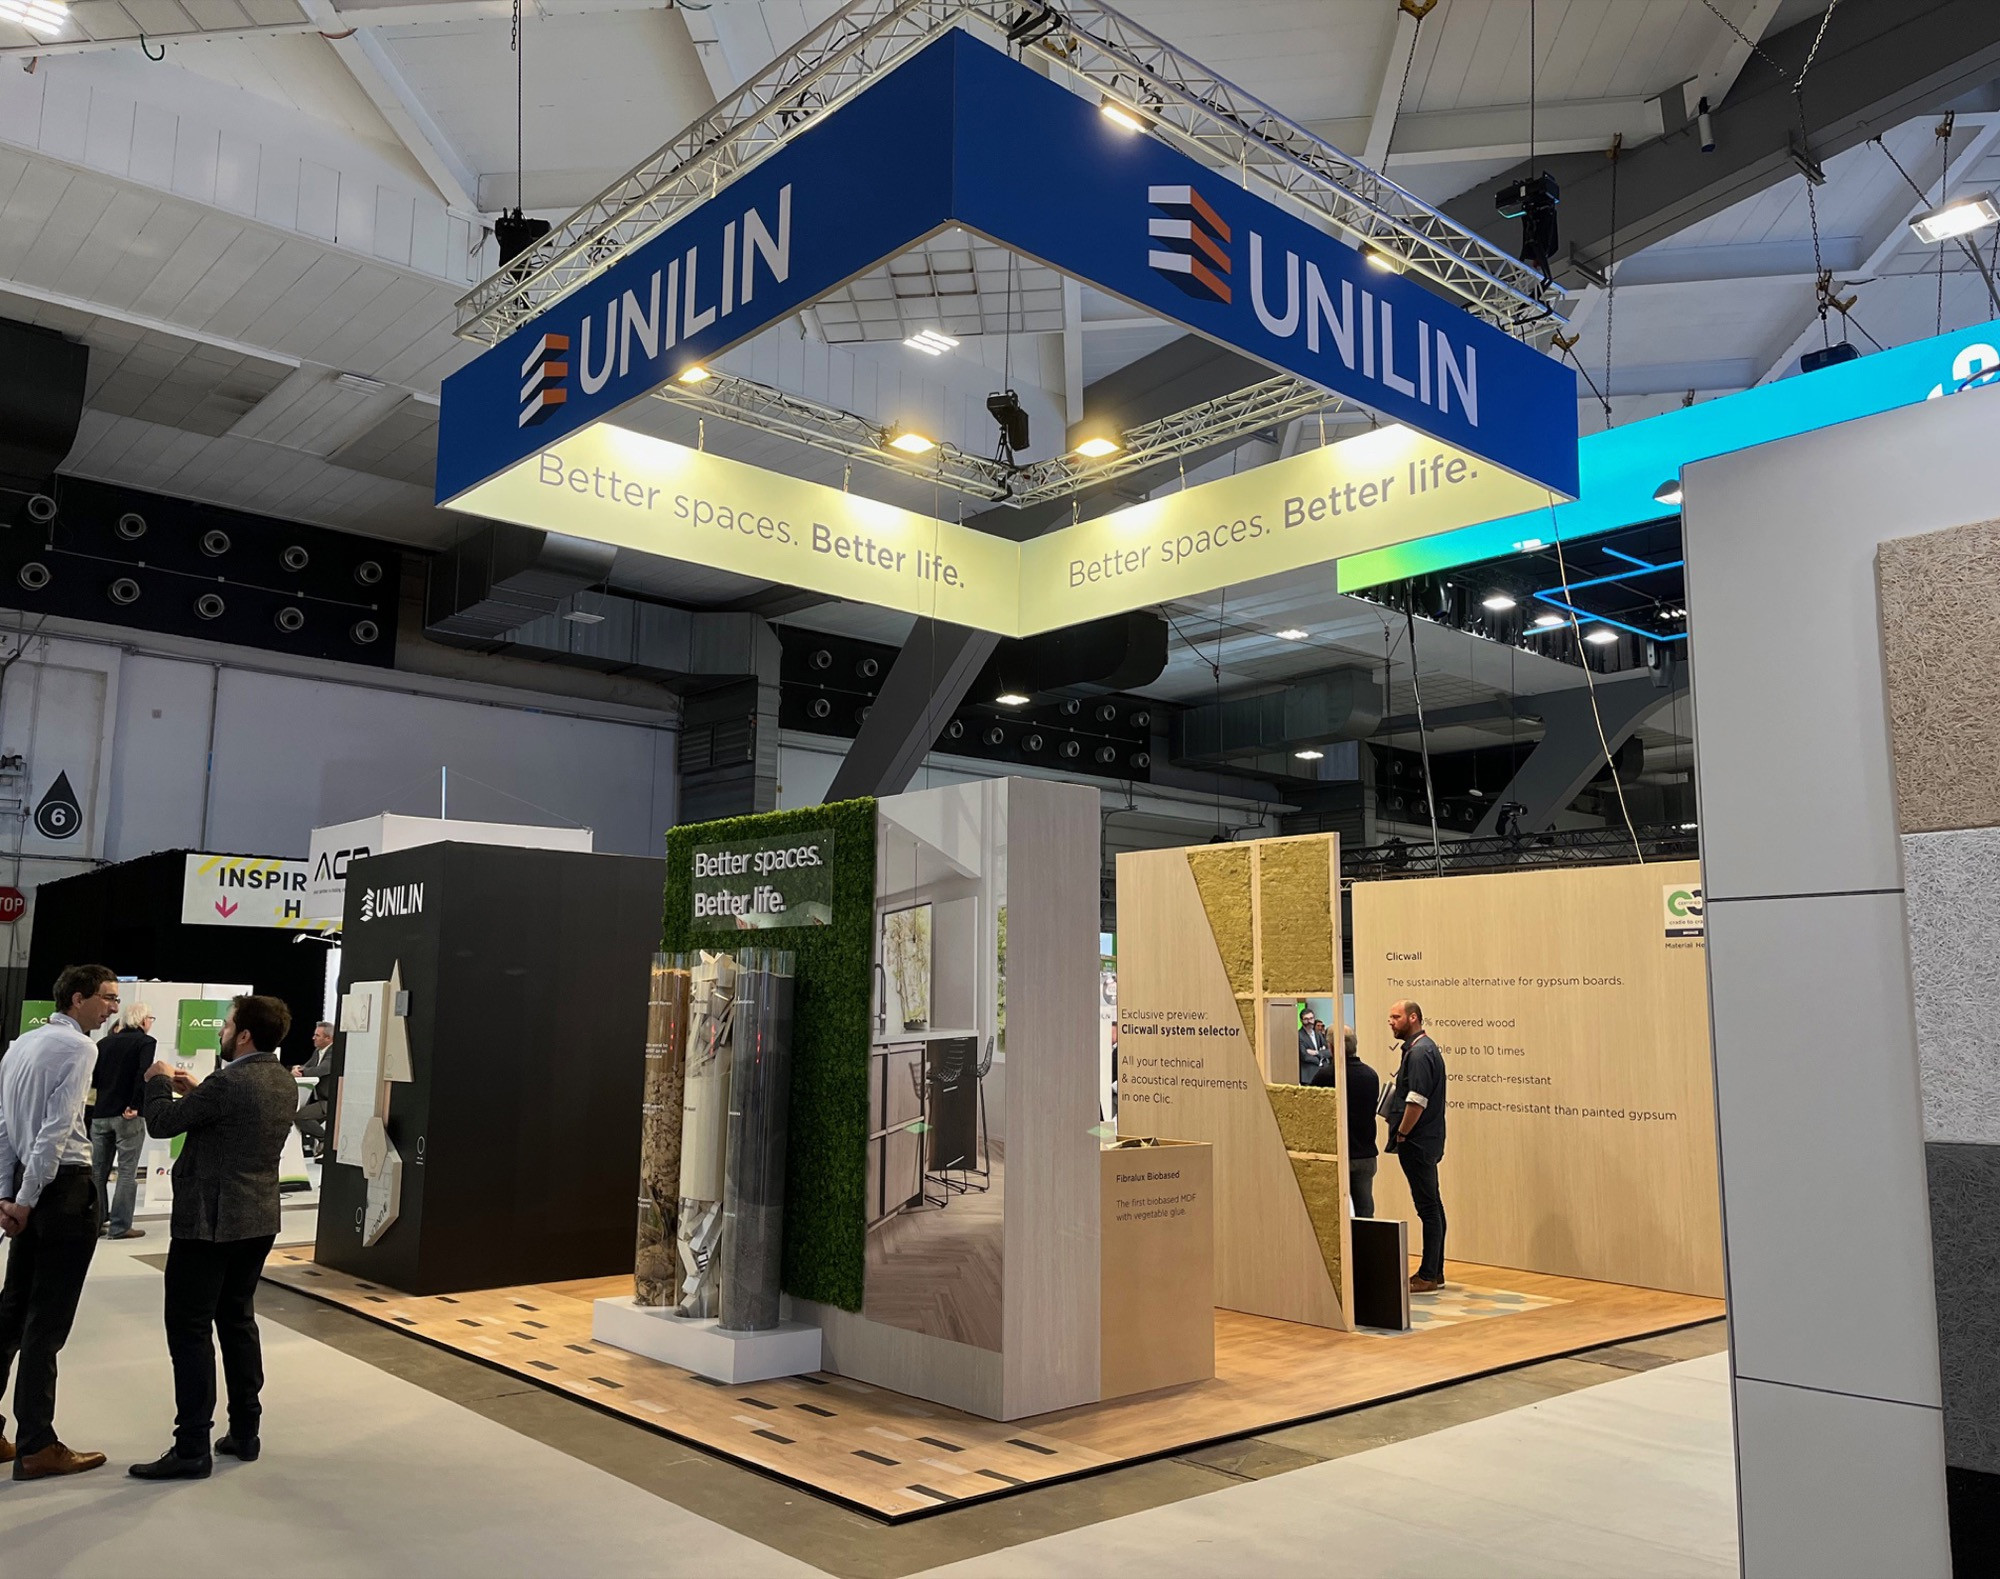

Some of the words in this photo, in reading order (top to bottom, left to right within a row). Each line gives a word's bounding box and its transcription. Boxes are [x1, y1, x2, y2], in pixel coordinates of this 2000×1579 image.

[580, 183, 792, 395] UNILIN
[1249, 231, 1478, 427] UNILIN
[539, 453, 661, 510] Better
[674, 494, 798, 546] spaces.
[812, 523, 906, 572] Better
[917, 550, 965, 588] life.
[1069, 541, 1151, 588] Better
[1161, 514, 1271, 565] spaces.
[1284, 476, 1394, 529] Better
[1408, 453, 1478, 496] life.
[51, 808, 66, 826] 6
[695, 851, 752, 878] Better
[753, 845, 823, 876] spaces.
[375, 882, 424, 917] UNILIN
[694, 890, 751, 917] Better
[753, 884, 787, 913] life.
[1665, 941, 1693, 949] Material
[1386, 951, 1422, 961] Clicwall
[1387, 977, 1404, 987] The
[1406, 977, 1460, 987] sustainable
[1462, 977, 1516, 987] alternative
[1518, 976, 1533, 986] for
[1536, 977, 1580, 987] gypsum
[1582, 975, 1625, 986] boards.
[1121, 1008, 1164, 1020] Exclusive
[1166, 1010, 1208, 1021] preview:
[1435, 1017, 1484, 1027] recovered
[1486, 1018, 1516, 1028] wood
[1121, 1023, 1159, 1035] Clicwall
[1161, 1025, 1196, 1037] system
[1198, 1025, 1240, 1036] selector
[1455, 1046, 1467, 1056] up
[1470, 1045, 1480, 1055] to
[1483, 1045, 1494, 1055] 10
[1497, 1046, 1526, 1056] times
[1121, 1055, 1134, 1066] All
[1137, 1058, 1158, 1068] your
[1160, 1057, 1204, 1069] technical
[1121, 1073, 1128, 1083] &
[1131, 1074, 1178, 1086] acoustical
[1181, 1077, 1248, 1090] requirements
[1445, 1073, 1464, 1082] ore
[1466, 1073, 1552, 1085] scratch-resistant
[1121, 1092, 1130, 1102] in
[1133, 1093, 1151, 1103] one
[1153, 1092, 1174, 1104] Clic.
[1467, 1101, 1551, 1115] impact-resistant
[1554, 1105, 1579, 1116] than
[1582, 1108, 1625, 1119] painted
[1628, 1110, 1677, 1122] gypsum
[1116, 1173, 1145, 1183] Fibralux
[1147, 1170, 1181, 1181] Biobased
[1117, 1200, 1130, 1208] The
[1132, 1198, 1146, 1207] first
[1147, 1195, 1179, 1206] biobased
[1116, 1212, 1132, 1222] with
[1134, 1209, 1168, 1220] vegetable
